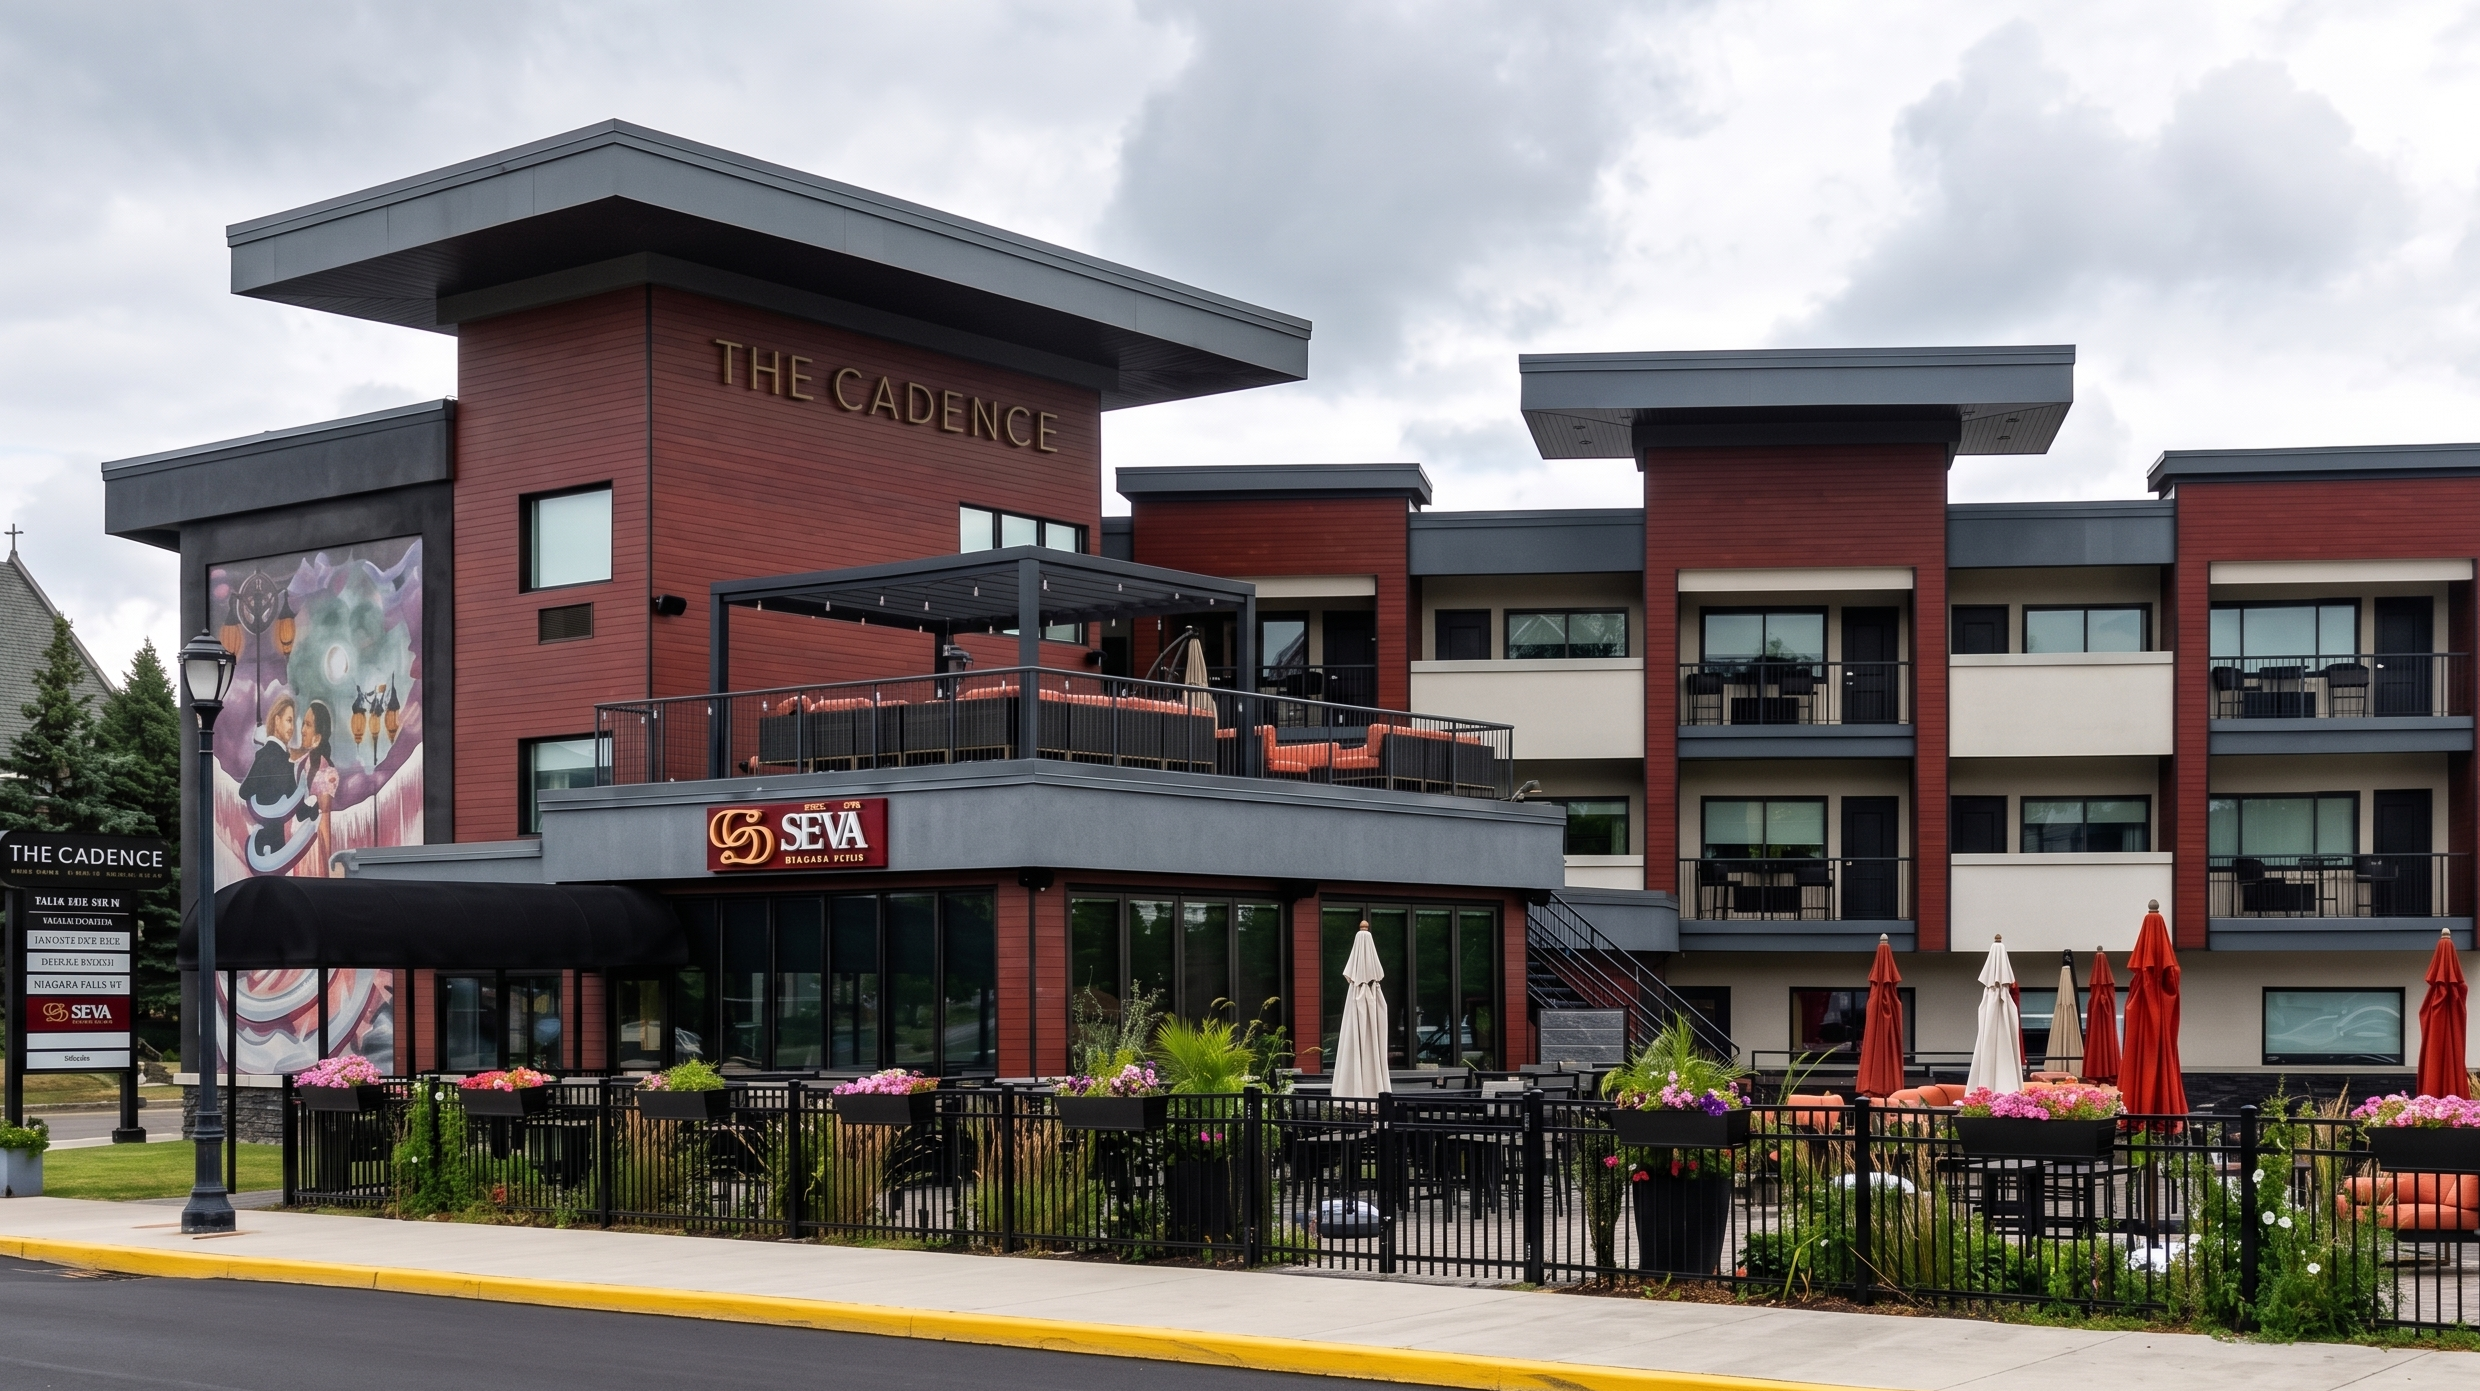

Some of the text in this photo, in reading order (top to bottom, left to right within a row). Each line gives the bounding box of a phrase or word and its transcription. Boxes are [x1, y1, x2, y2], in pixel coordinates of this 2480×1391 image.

[714, 338, 1058, 453] THE CADENCE
[781, 811, 868, 851] SEVA
[9, 844, 163, 867] THE CADENCE
[34, 980, 78, 989] NIAGARA
[81, 980, 106, 989] FALLS
[71, 1004, 112, 1019] SEVA
